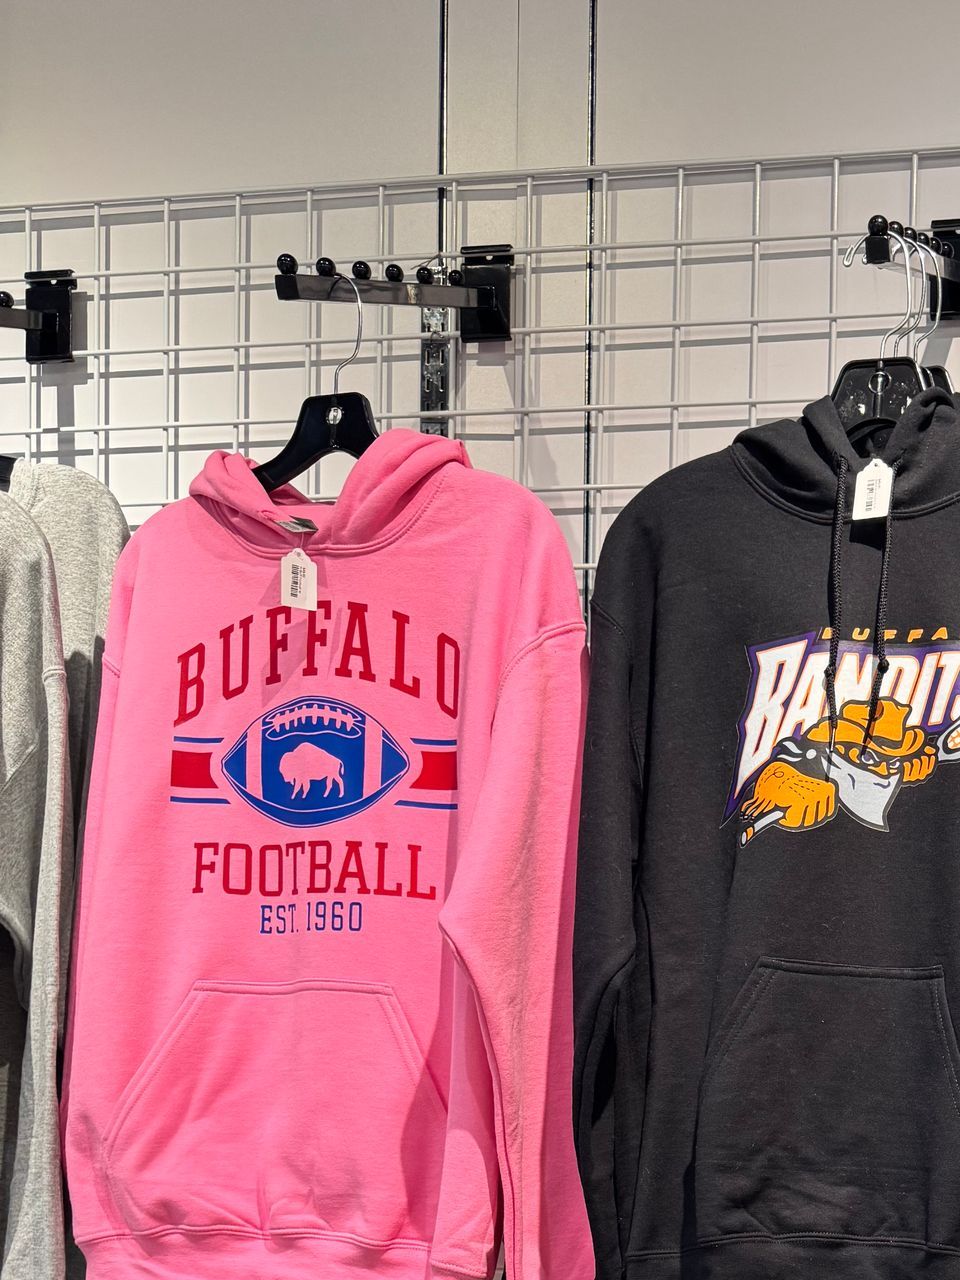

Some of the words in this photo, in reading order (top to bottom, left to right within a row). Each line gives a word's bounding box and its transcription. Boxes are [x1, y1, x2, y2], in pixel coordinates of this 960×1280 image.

[173, 600, 461, 727] BUFFALO
[191, 839, 437, 900] FOOTBALL
[260, 904, 299, 934] EST.
[306, 901, 363, 932] 1960
